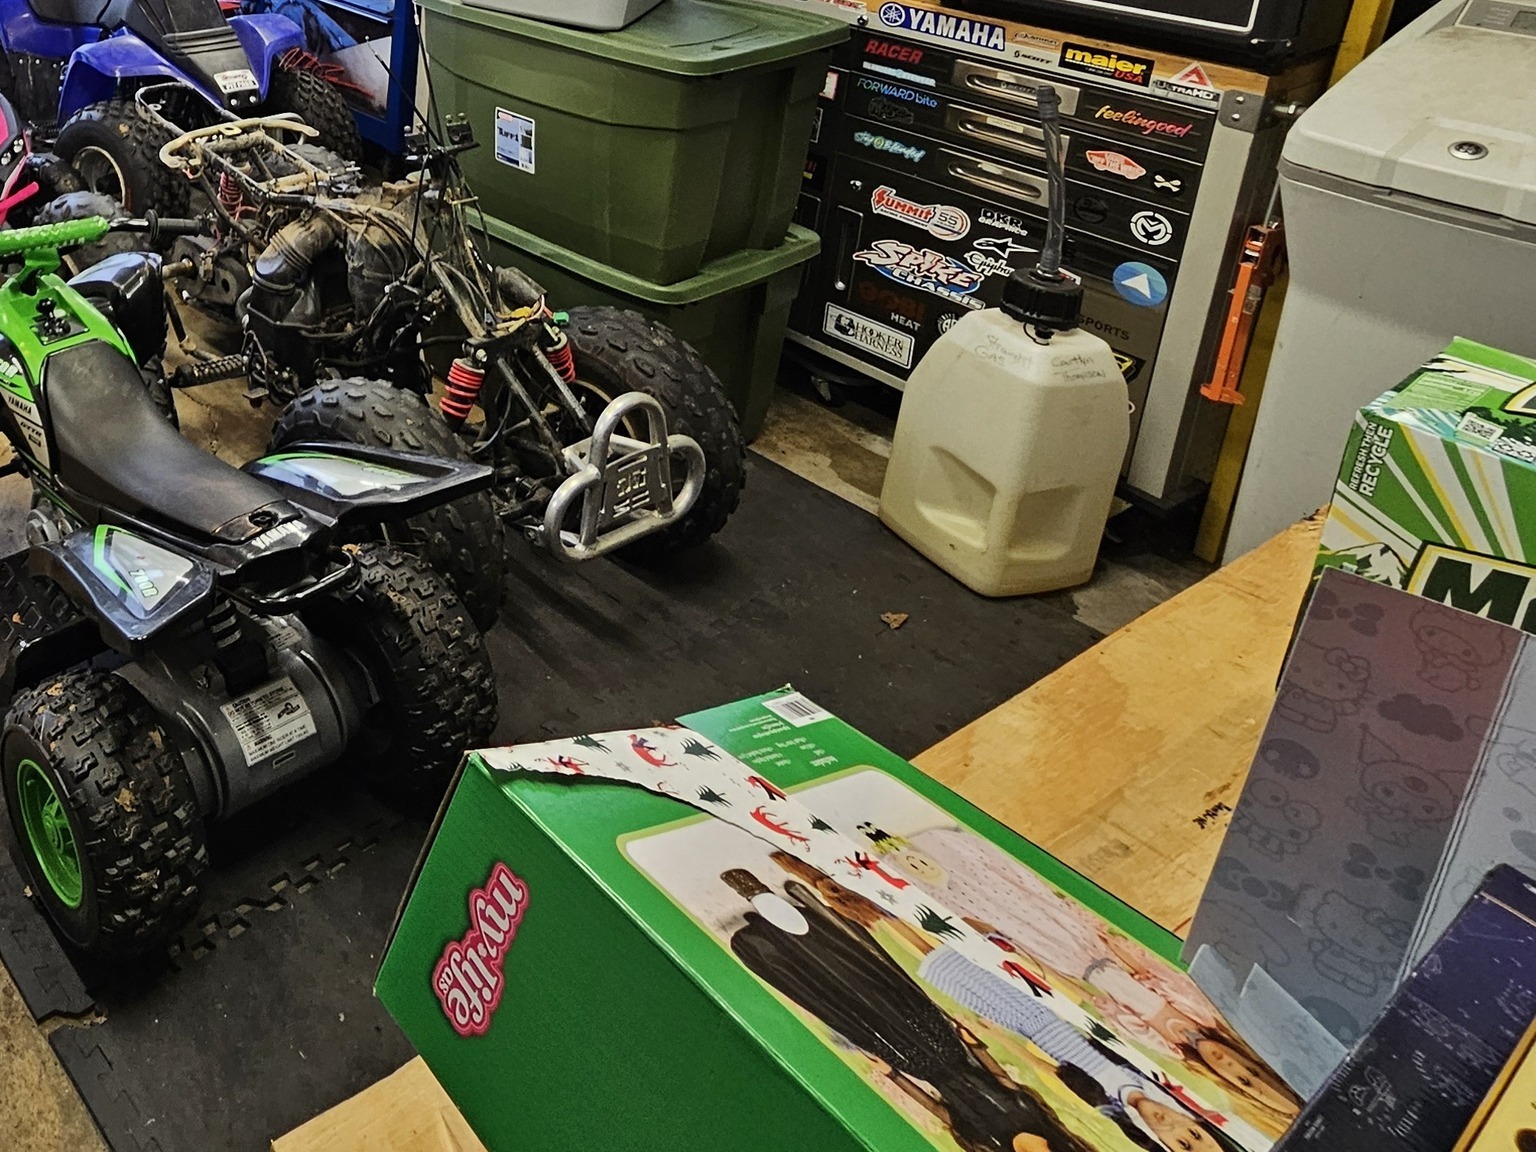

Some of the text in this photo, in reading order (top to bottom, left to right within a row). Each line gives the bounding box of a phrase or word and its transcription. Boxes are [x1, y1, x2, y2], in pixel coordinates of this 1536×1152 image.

[908, 8, 1004, 50] YAMAHA
[866, 39, 923, 64] RACER
[1065, 48, 1146, 75] maier
[857, 77, 938, 109] FORWARD bite
[1114, 71, 1143, 85] USA
[1095, 105, 1193, 138] feelingood
[938, 211, 958, 226] 55
[892, 269, 985, 310] CHASSIS
[855, 320, 903, 350] HOOKER
[891, 312, 921, 331] HEAT
[854, 331, 904, 359] HARNESS
[8, 396, 33, 416] YAMAHA
[1350, 421, 1378, 491] REFRESH THEN
[1359, 424, 1394, 498] RECYCLE
[251, 520, 308, 550] YAMAHA
[1422, 555, 1536, 634] M
[447, 945, 499, 1026] life
